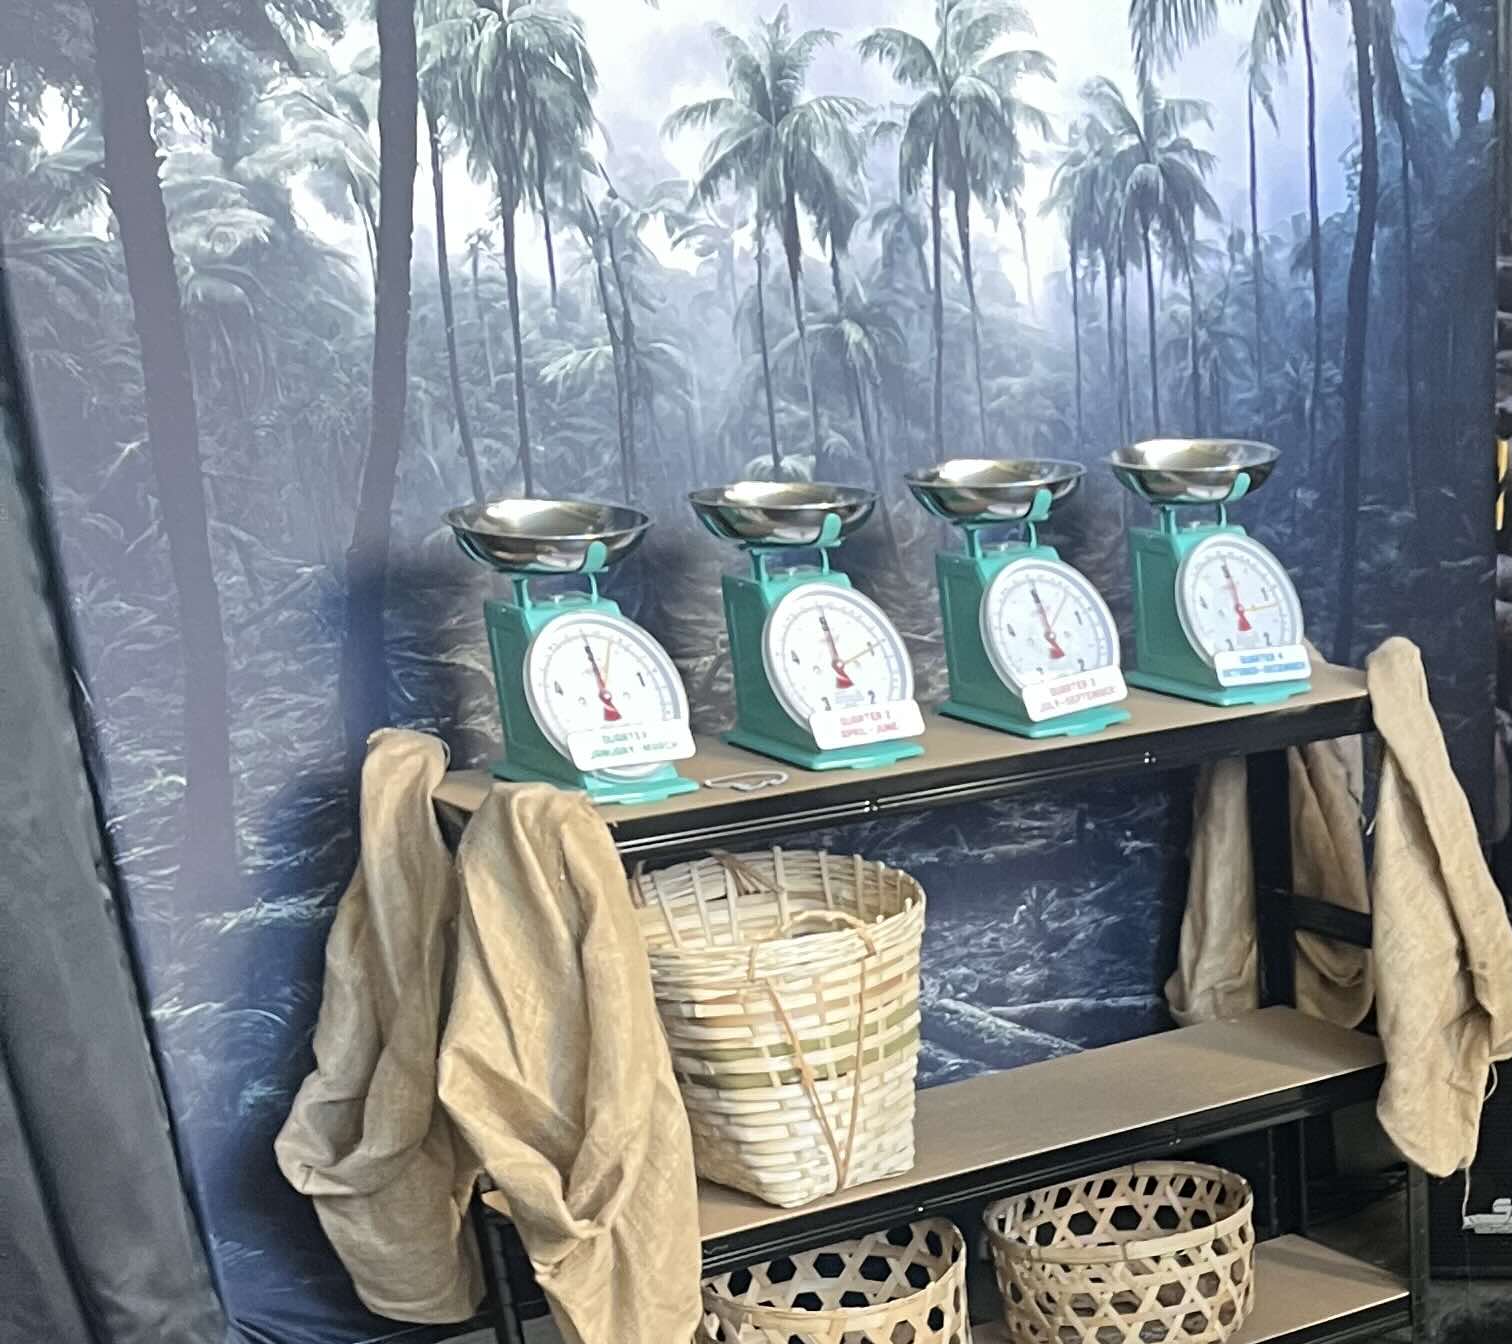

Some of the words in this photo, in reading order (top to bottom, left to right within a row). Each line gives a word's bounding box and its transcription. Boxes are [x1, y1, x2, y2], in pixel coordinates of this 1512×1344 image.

[1261, 587, 1268, 601] 1
[1075, 611, 1082, 625] 1
[637, 672, 645, 686] 1
[554, 681, 563, 696] 4
